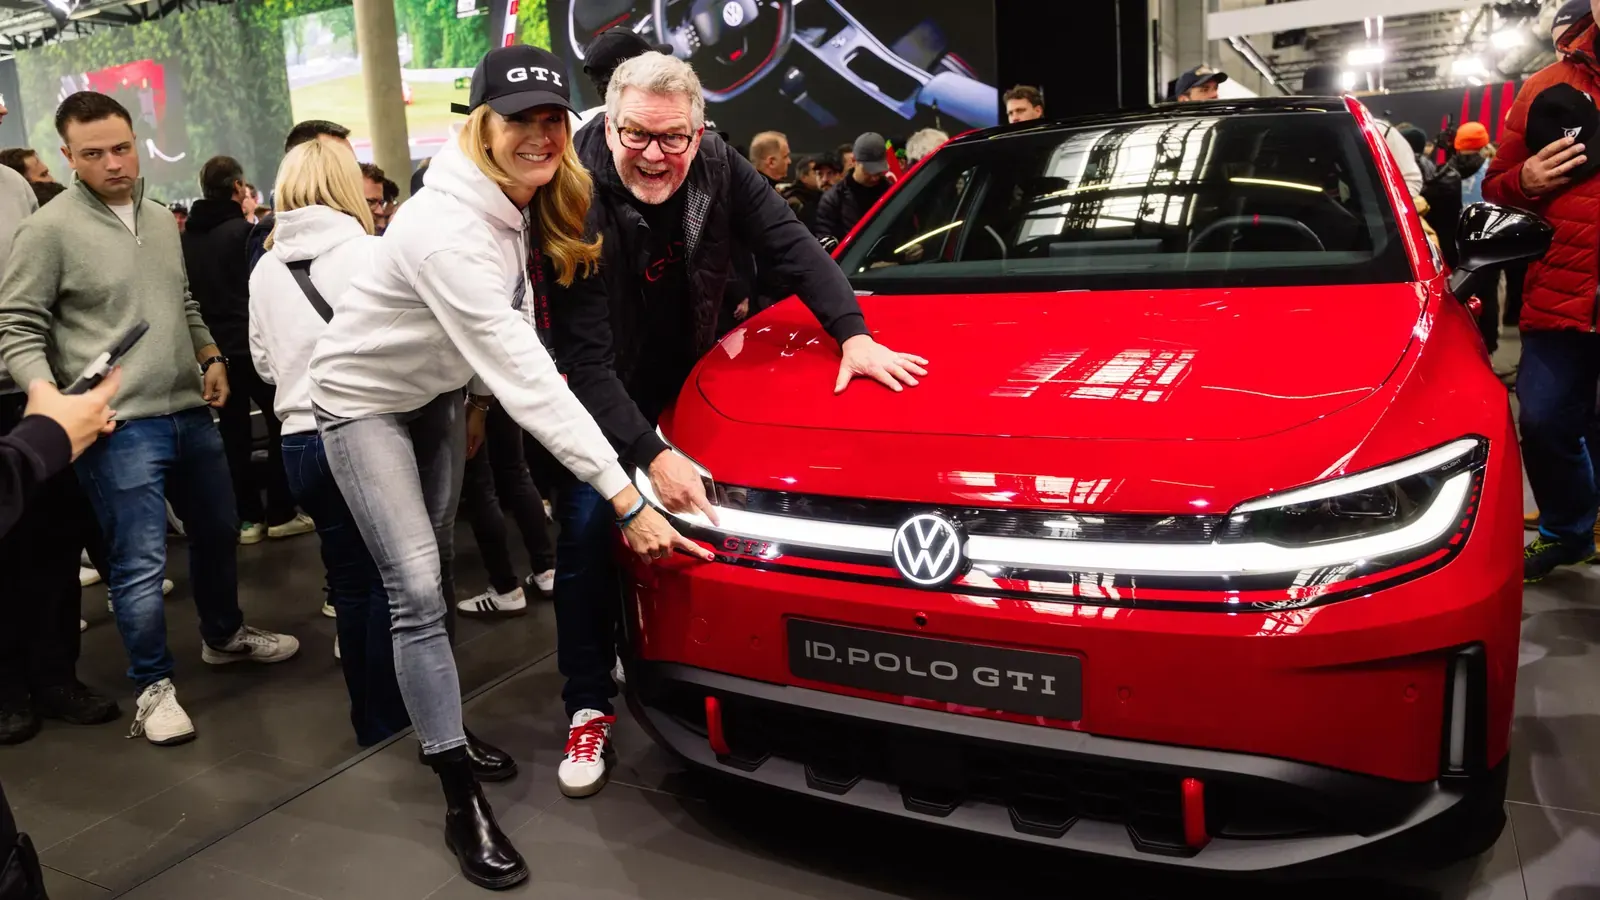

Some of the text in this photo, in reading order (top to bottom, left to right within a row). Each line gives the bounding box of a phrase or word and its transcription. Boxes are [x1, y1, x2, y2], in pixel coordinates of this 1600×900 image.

[506, 66, 563, 87] GTI
[723, 536, 771, 556] GTI
[972, 666, 1056, 695] GTI
